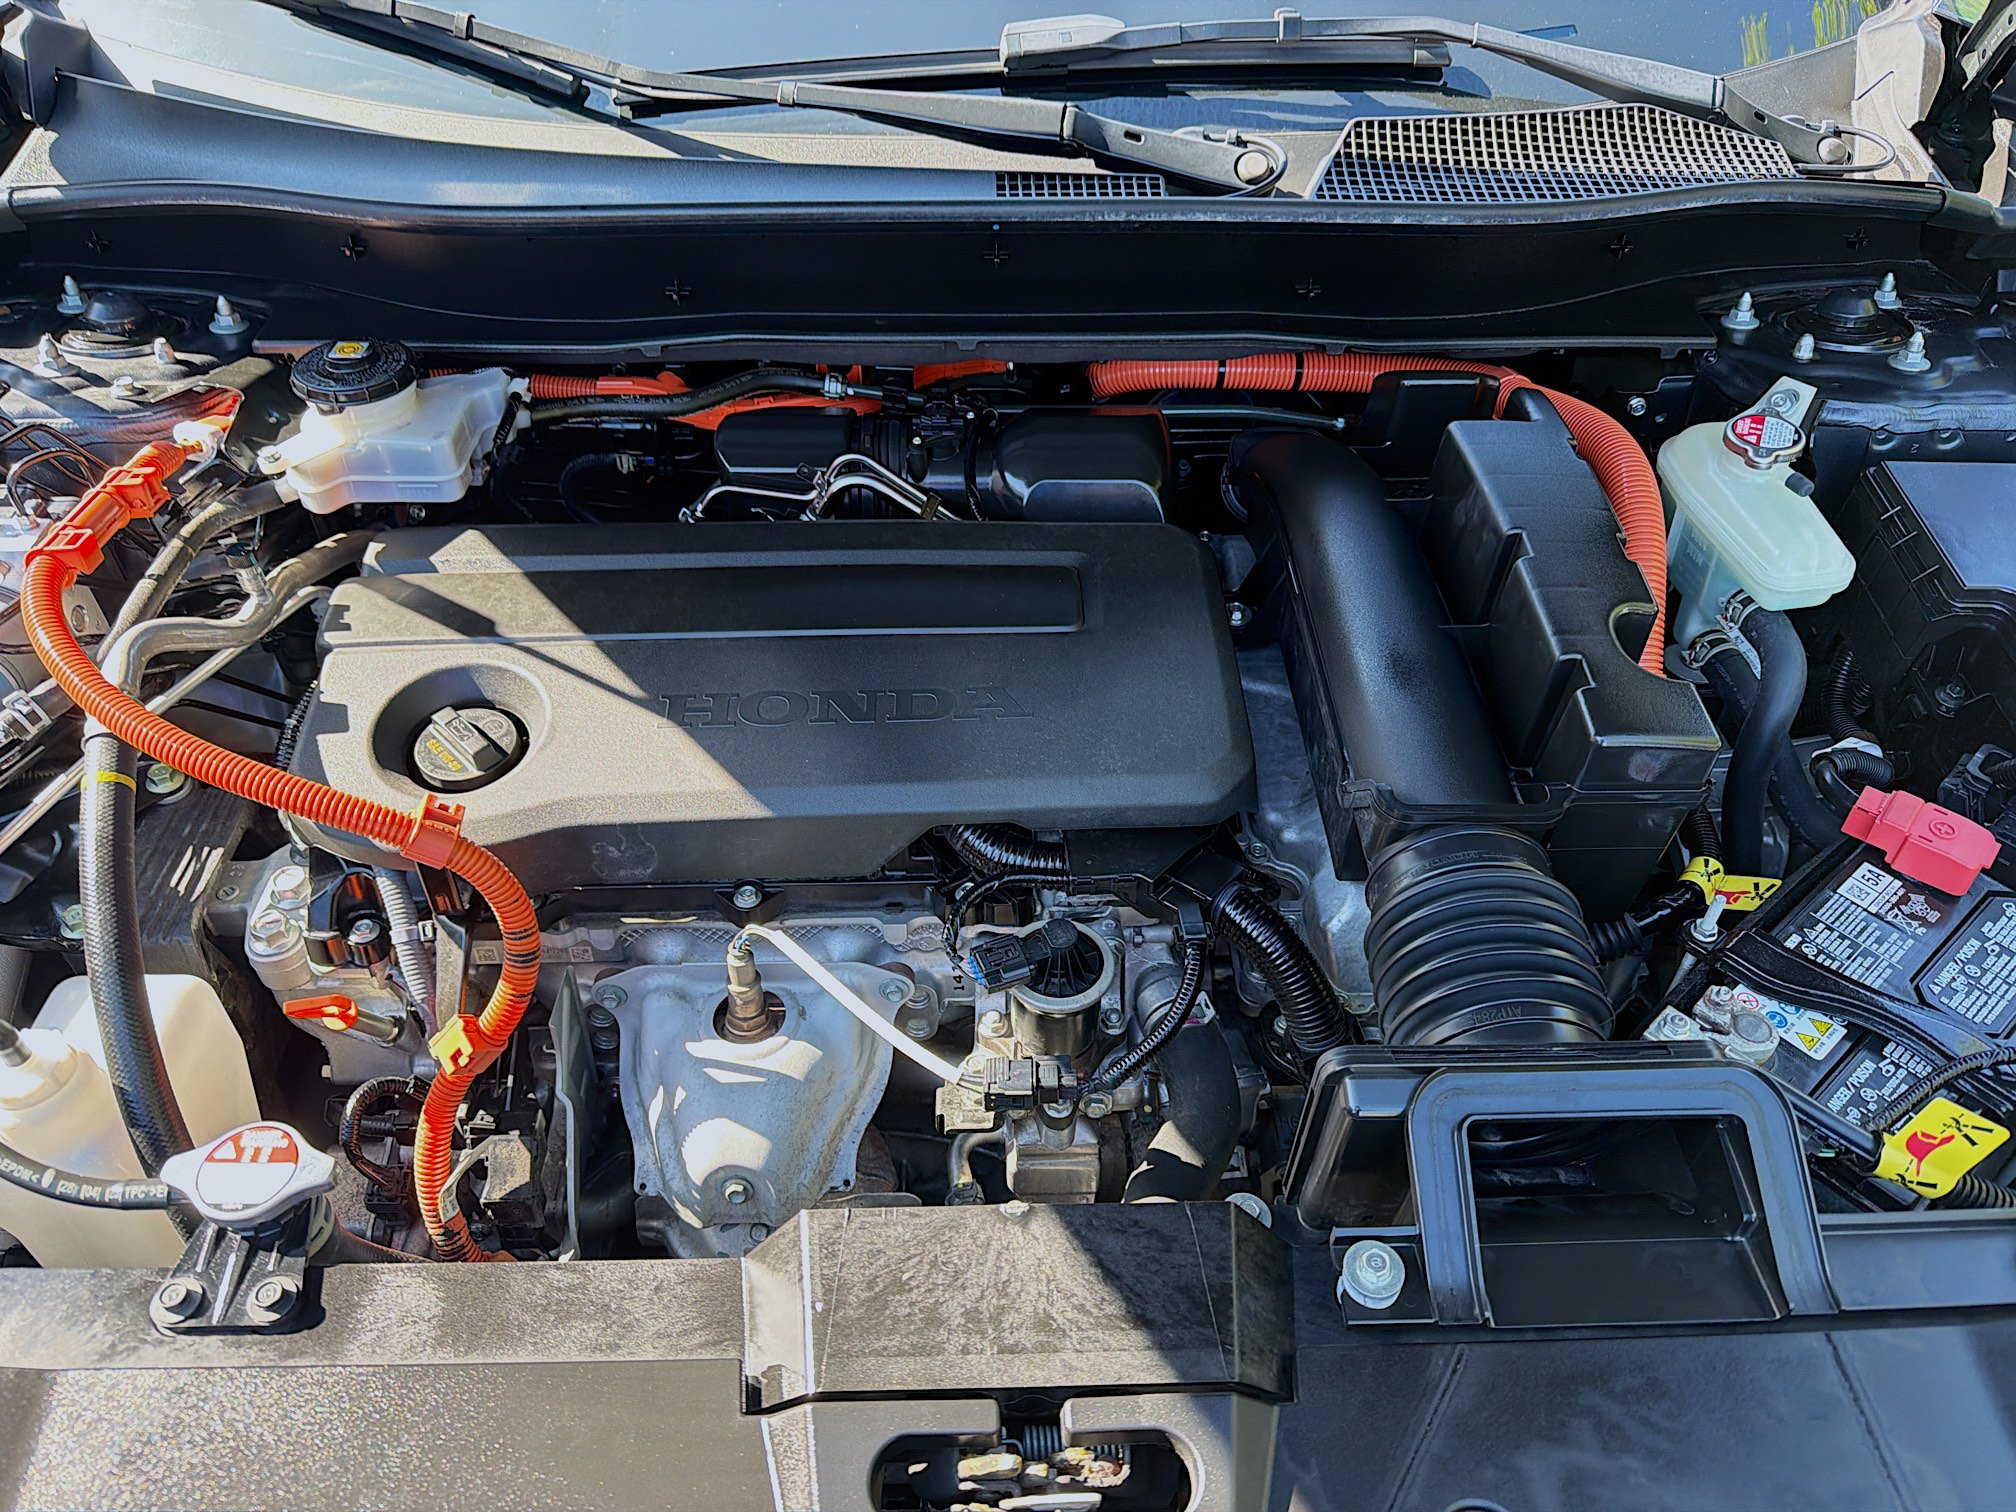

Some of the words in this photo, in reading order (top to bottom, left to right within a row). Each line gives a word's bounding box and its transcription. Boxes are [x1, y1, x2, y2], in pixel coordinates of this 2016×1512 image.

[656, 686, 1034, 729] HONDA
[1861, 868, 1886, 887] 5A
[0, 1157, 40, 1184] EPDM<
